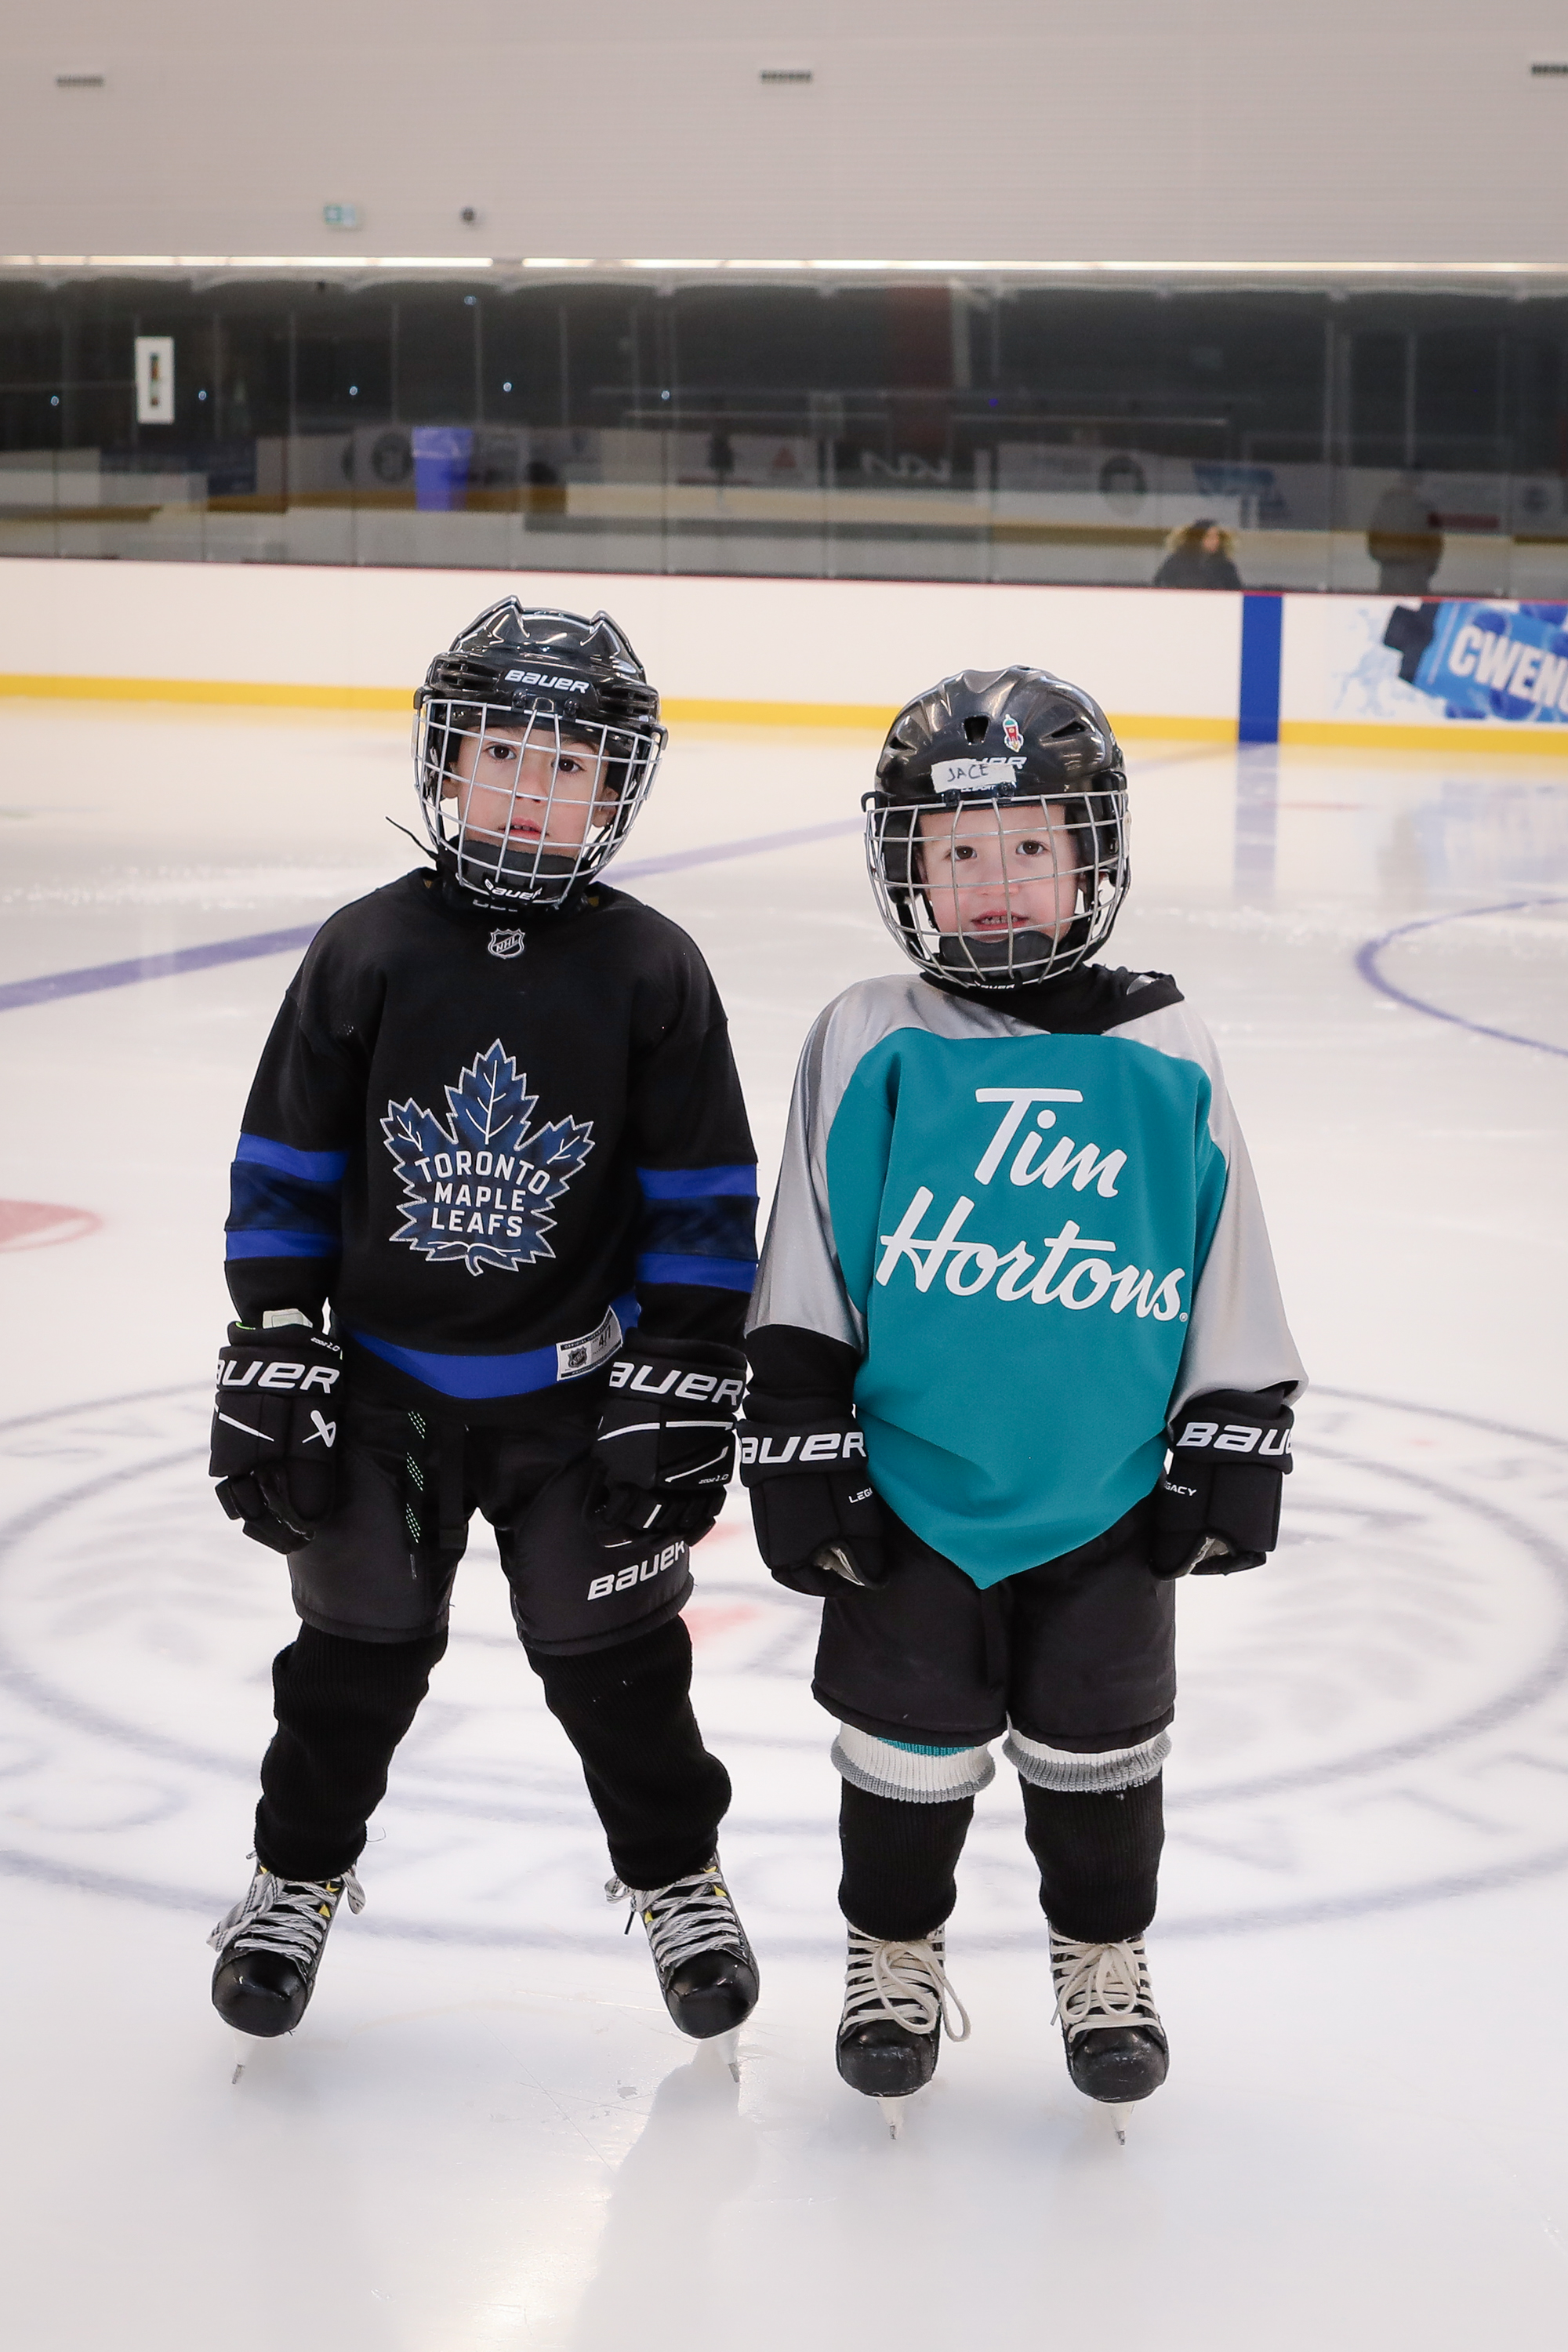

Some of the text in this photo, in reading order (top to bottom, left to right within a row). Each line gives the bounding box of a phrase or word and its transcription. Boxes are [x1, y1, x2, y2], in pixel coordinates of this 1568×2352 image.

[504, 669, 590, 694] BAUER
[1449, 626, 1568, 715] CWEN
[947, 763, 989, 782] JACE
[495, 936, 518, 952] NHL
[974, 1087, 1128, 1198] Tim
[414, 1150, 550, 1196] TORONTO
[434, 1181, 526, 1212] MAPLE
[431, 1207, 523, 1238] LEAFS
[875, 1185, 1185, 1322] Hortons
[216, 1359, 340, 1394] UER
[609, 1361, 743, 1406] AUER
[741, 1432, 867, 1465] AUER
[1176, 1421, 1292, 1456] BAU
[848, 1487, 873, 1504] LEG
[1163, 1481, 1197, 1497] GACY
